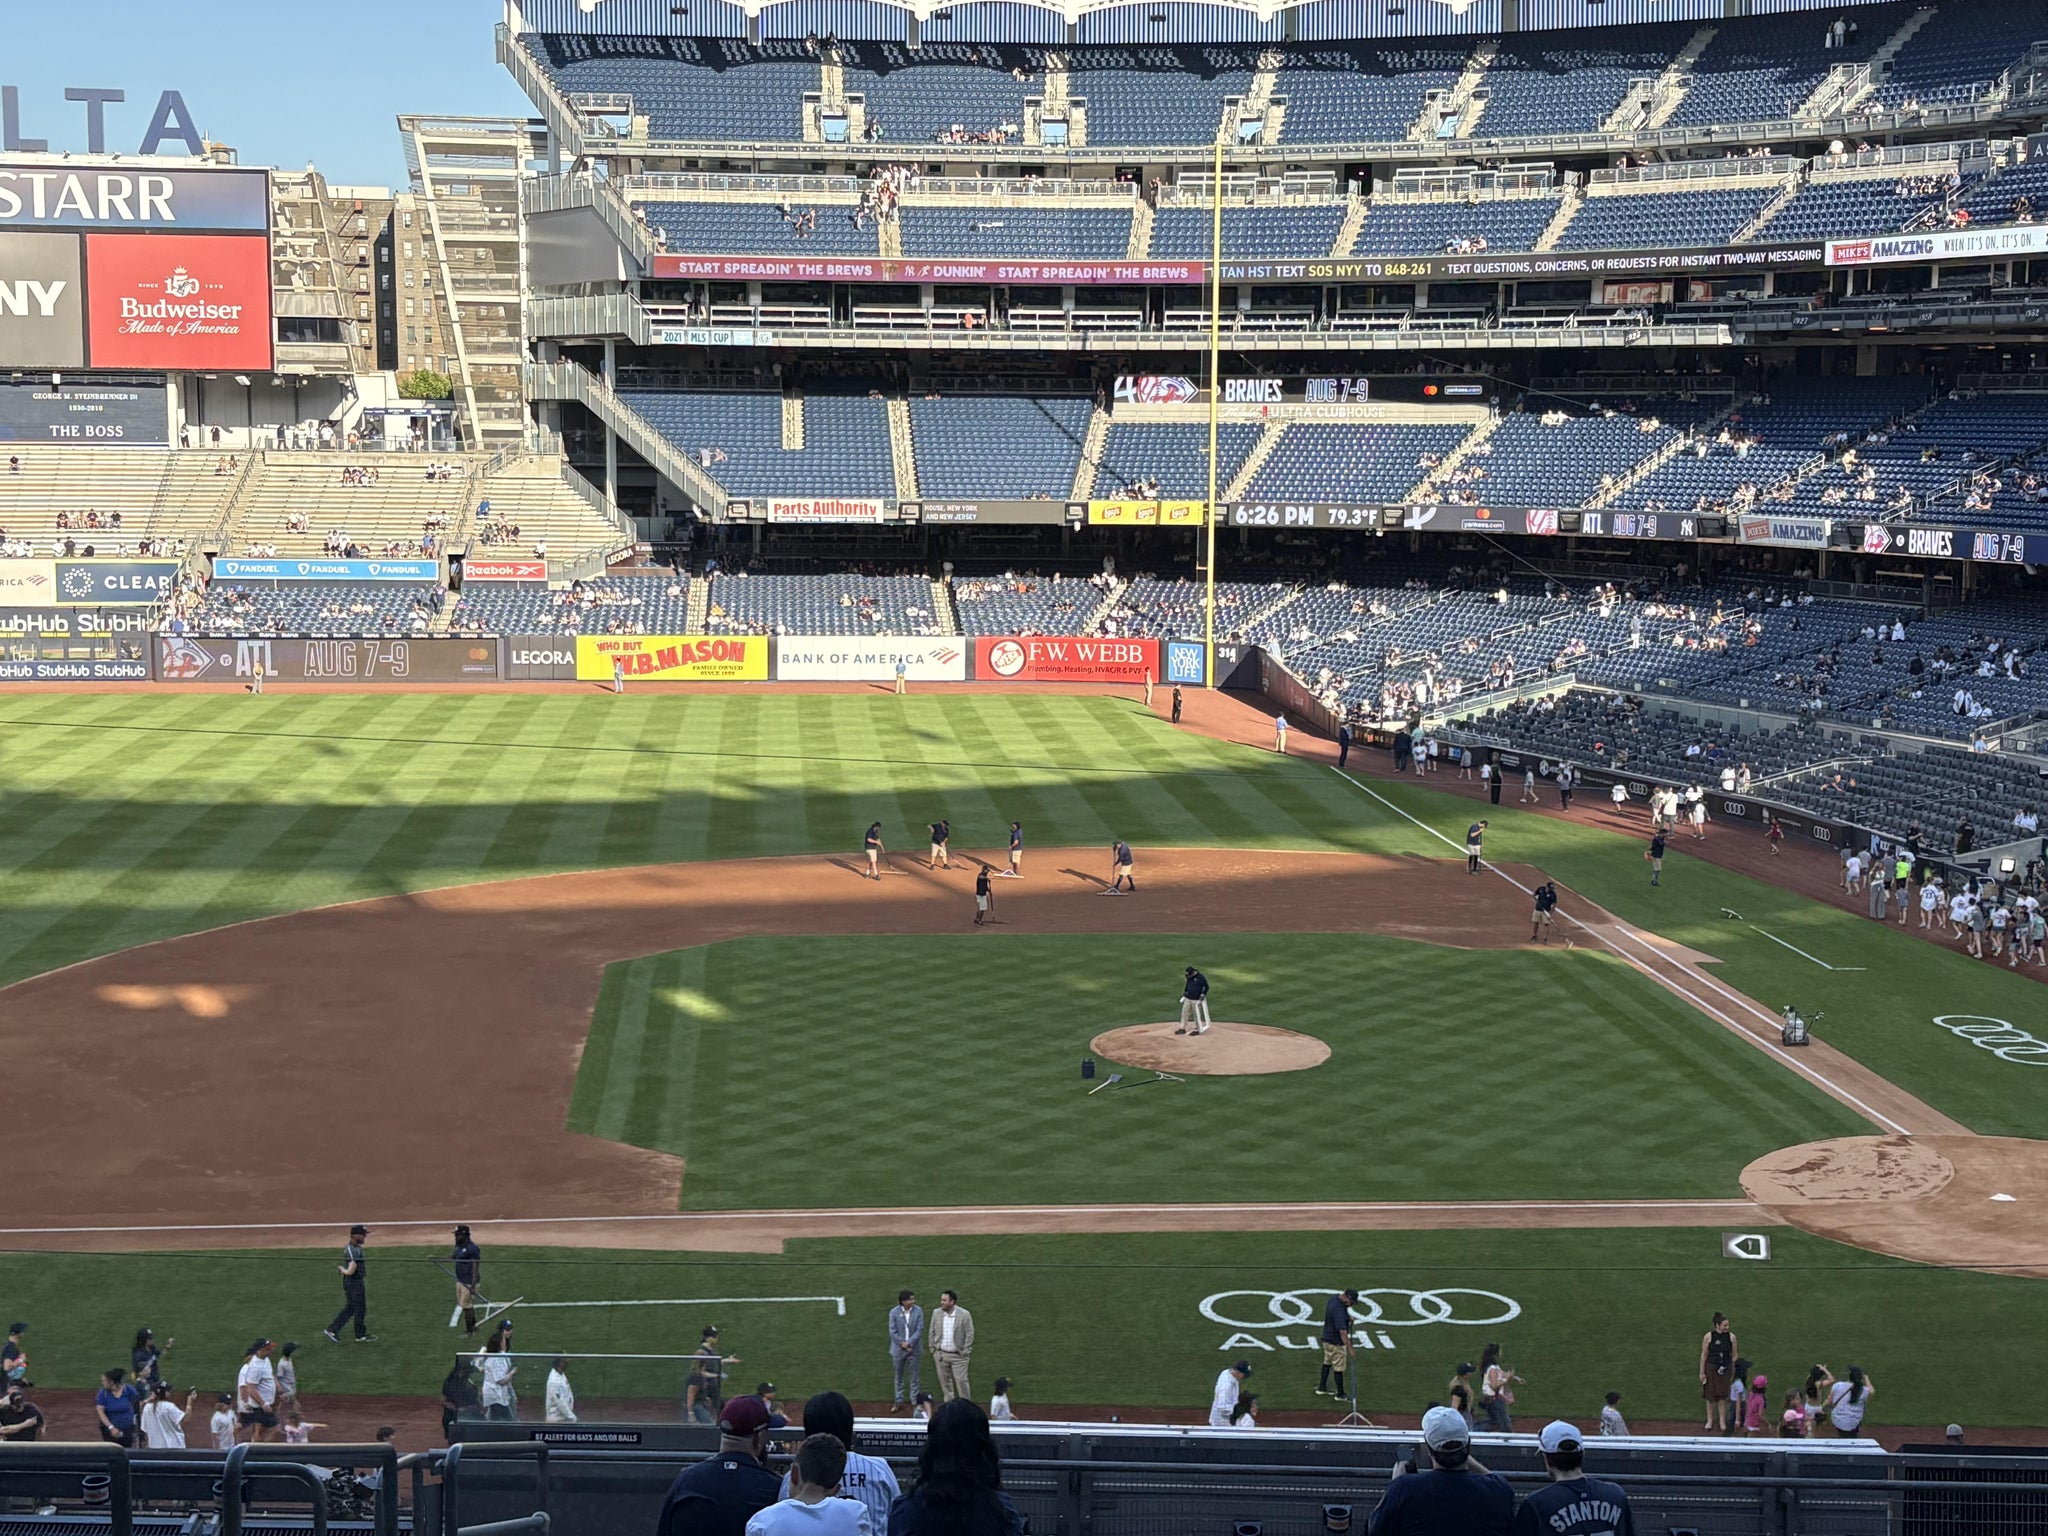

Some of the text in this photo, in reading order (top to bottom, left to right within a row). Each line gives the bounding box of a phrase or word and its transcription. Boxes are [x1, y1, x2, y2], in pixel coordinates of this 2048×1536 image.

[1872, 239, 1934, 257] AMAZING
[2002, 233, 2018, 248] IT'S
[679, 262, 721, 274] START
[724, 263, 794, 275] SPREADIN'
[797, 264, 823, 275] THE
[826, 265, 873, 276] BREWS
[1275, 265, 1306, 278] TEXT
[1308, 265, 1333, 277] SOS
[1336, 264, 1363, 277] NYY
[1365, 264, 1382, 276] TO
[1384, 263, 1432, 276] 848-261
[1447, 263, 1472, 274] TEXT
[1473, 262, 1533, 274] QUESTIONS,
[1534, 260, 1589, 273] CONCERNS,
[1591, 259, 1605, 270] OR
[1607, 257, 1657, 269] REQUESTS
[1659, 256, 1679, 268] FOR
[1681, 254, 1721, 267] INSTANT
[1723, 252, 1766, 264] TWO-WAY
[1767, 249, 1822, 262] MESSAGING
[933, 266, 1189, 279] DUNKIN' START SPREADIN' THE BREWS
[120, 297, 242, 319] Budweiser
[118, 318, 240, 336] Made of America
[664, 331, 729, 343] 2021 MLS CUP
[1225, 379, 1283, 403] BRAVES
[1305, 379, 1337, 403] AUG
[1341, 379, 1368, 403] 7-9
[1271, 406, 1312, 417] ULTRA
[1316, 406, 1385, 418] CLUBHOUSE
[49, 425, 124, 437] THE BOSS
[773, 503, 810, 515] Parts
[1235, 506, 1377, 525] 6:26 PM 79.3°F
[1463, 521, 1503, 530] yankees.com
[1582, 513, 1604, 534] ATL
[1613, 513, 1635, 536] AUG
[1636, 514, 1657, 537] 7-9
[1772, 522, 1823, 542] AMAZING
[1908, 529, 1953, 556] BRAVES
[1972, 533, 1999, 560] AUG
[2001, 534, 2024, 562] 7-9
[240, 565, 280, 573] FANDUEL
[311, 565, 350, 574] FANDUEL
[466, 565, 514, 576] Reebok
[104, 575, 170, 589] CLEAR
[597, 641, 643, 652] WHO BUT
[1174, 647, 1198, 657] NEW
[1218, 647, 1237, 659] 314
[235, 641, 409, 677] ATL AUG 7-9
[512, 650, 575, 665] LEGORA
[782, 654, 824, 664] BANK
[830, 654, 849, 664] OF
[1028, 643, 1143, 664] F.W. WEBB
[1170, 656, 1200, 669] YORK
[37, 665, 90, 677] StubHub
[94, 665, 146, 677] StubHub
[1174, 667, 1197, 678] LIFE
[618, 1434, 638, 1442] BALLS
[1549, 1500, 1622, 1533] STANTON
